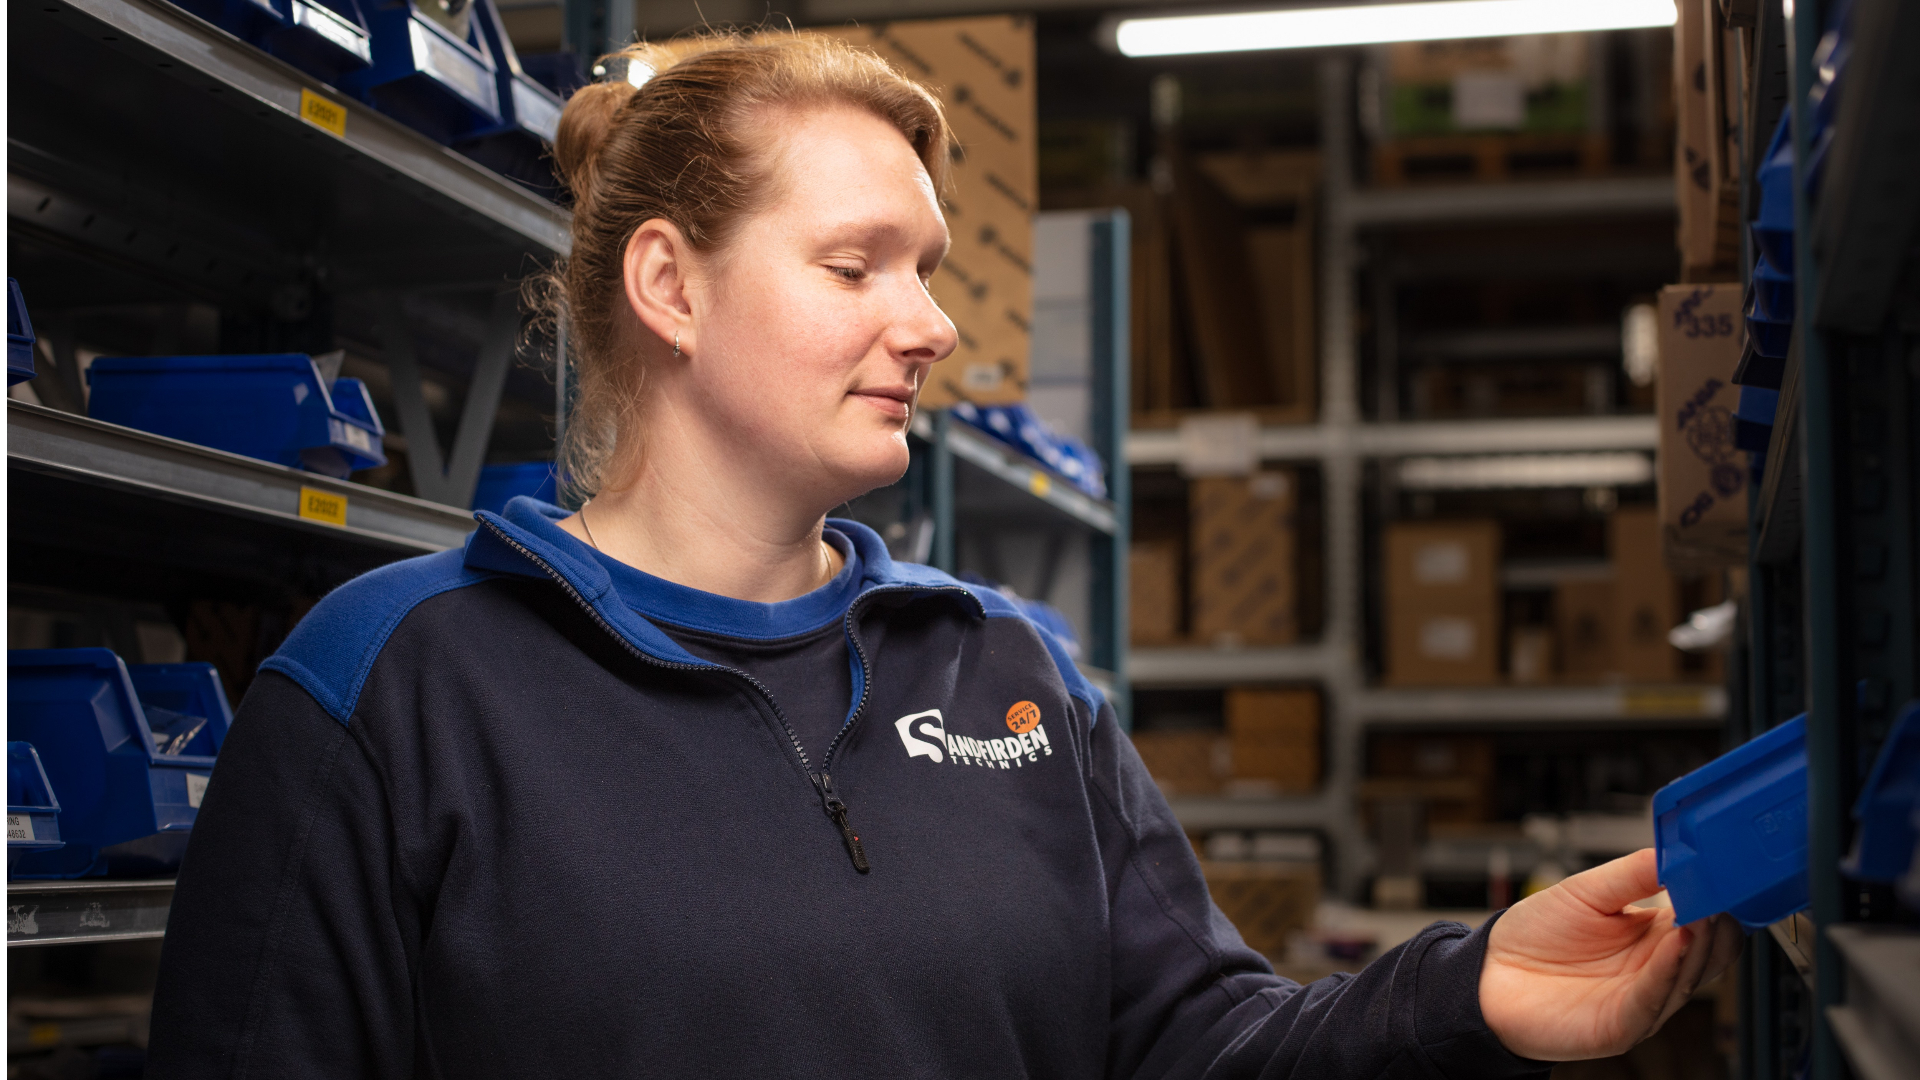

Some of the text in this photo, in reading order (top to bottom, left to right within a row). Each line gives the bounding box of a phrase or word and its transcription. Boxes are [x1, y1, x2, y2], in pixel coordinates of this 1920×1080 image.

[308, 495, 339, 518] E2022
[1008, 703, 1033, 722] SERVICE
[1011, 709, 1037, 730] 24/7
[951, 745, 1053, 770] TECHNICS
